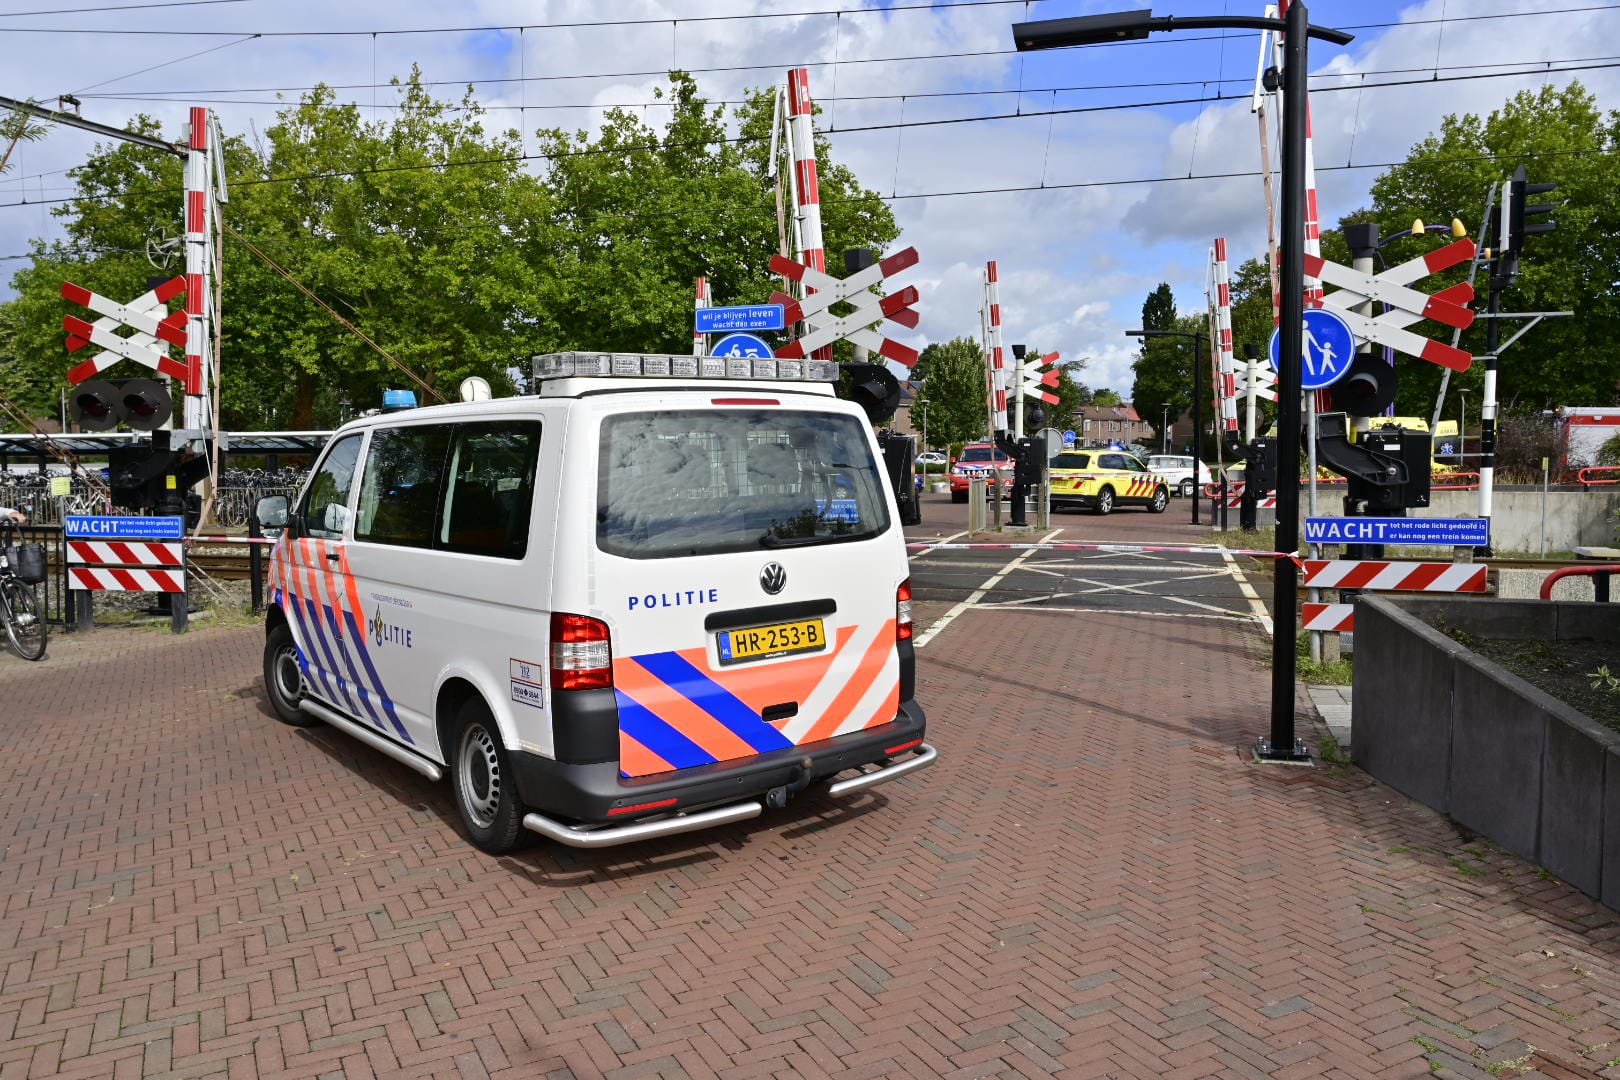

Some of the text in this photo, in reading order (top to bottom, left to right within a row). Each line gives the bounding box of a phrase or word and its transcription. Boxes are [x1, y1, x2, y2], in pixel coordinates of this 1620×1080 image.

[714, 313, 721, 321] je
[723, 311, 747, 321] blijven
[749, 309, 774, 318] leven
[67, 520, 119, 533] WACHT
[1306, 522, 1388, 538] WACHT
[1448, 523, 1477, 531] gedoofd
[628, 588, 718, 611] POLITIE
[368, 618, 412, 648] POLITIE
[735, 624, 818, 654] HR-253-B
[722, 648, 731, 656] NL
